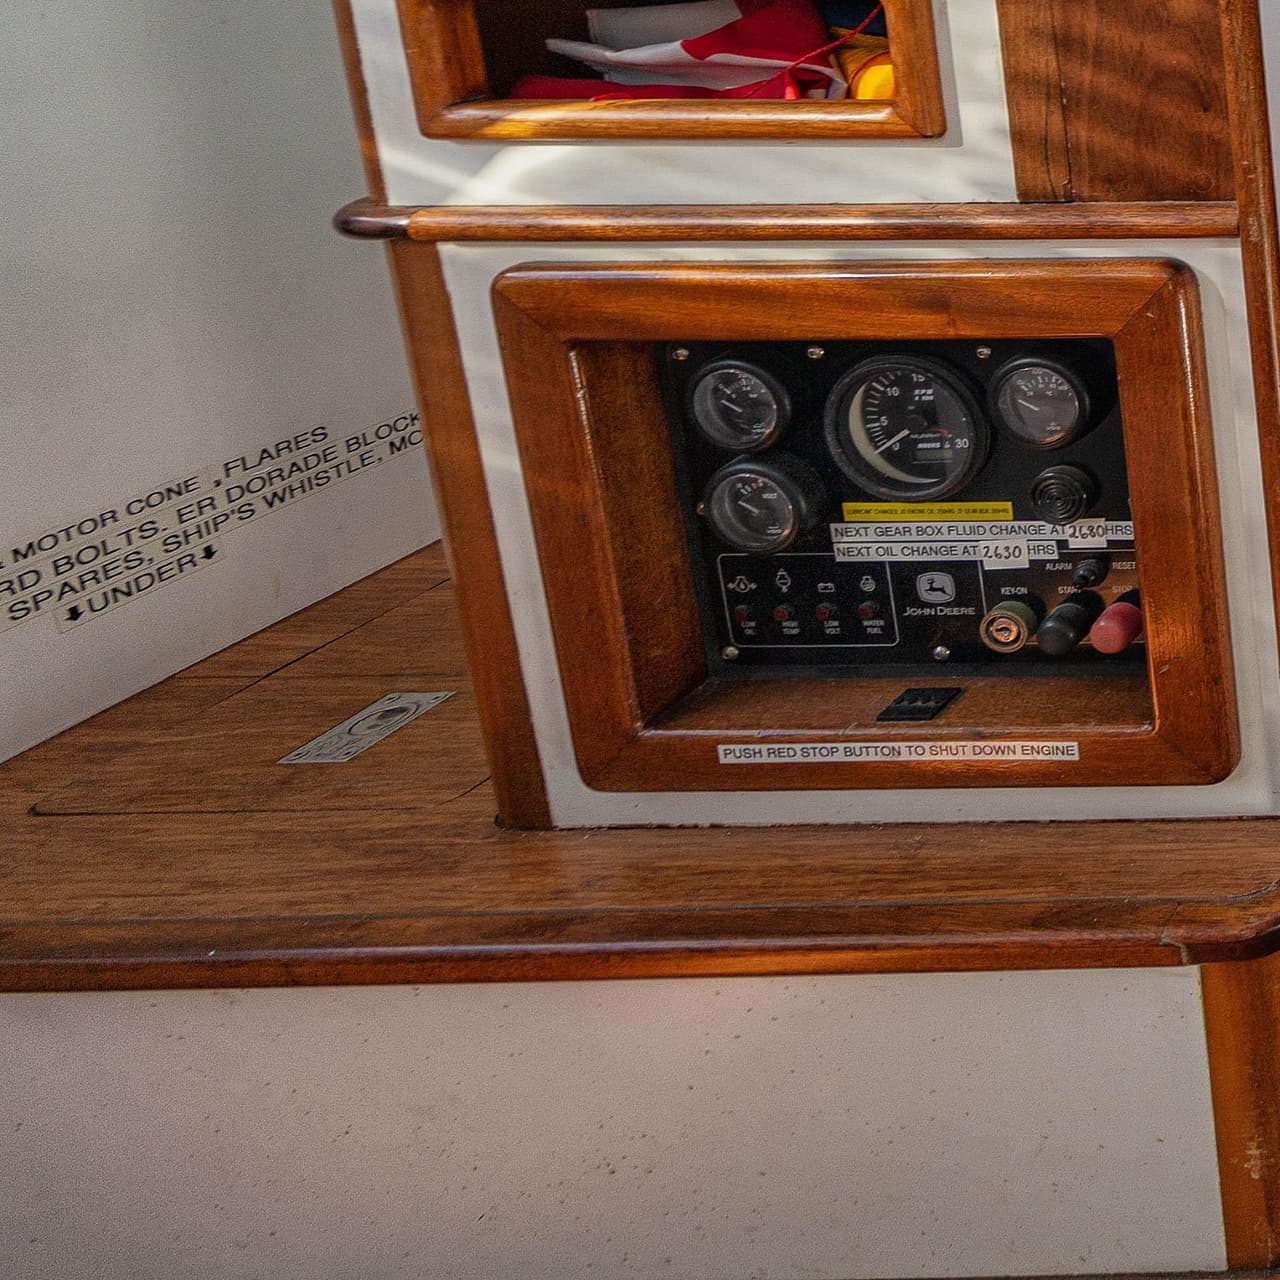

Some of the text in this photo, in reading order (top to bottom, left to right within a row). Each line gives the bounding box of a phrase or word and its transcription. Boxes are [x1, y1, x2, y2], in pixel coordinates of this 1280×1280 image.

[886, 387, 900, 396] 10
[954, 438, 969, 448] 30
[11, 475, 200, 561] MOTOR CONE
[51, 521, 169, 578] BOLTS.
[176, 497, 218, 524] ER
[225, 448, 338, 504] DORADE
[8, 550, 155, 623] SPARES,
[162, 501, 256, 554] SHIP'S
[262, 453, 383, 509] WHISTLE,
[834, 524, 1133, 539] NEXT GEAR BOX FLUID CHANGE AT 2680 HRS
[836, 545, 1055, 560] NEXT OIL CHANGE AT 2630 HRS
[1045, 562, 1073, 571] ALARM
[1112, 561, 1137, 570] RESET
[87, 552, 198, 614] UNDER
[1000, 586, 1028, 595] KEY-ON
[903, 606, 976, 616] JOHN DEERE
[723, 745, 1076, 759] PUSH RED STOP BUTTON TO SHUT DOWN ENGINE
